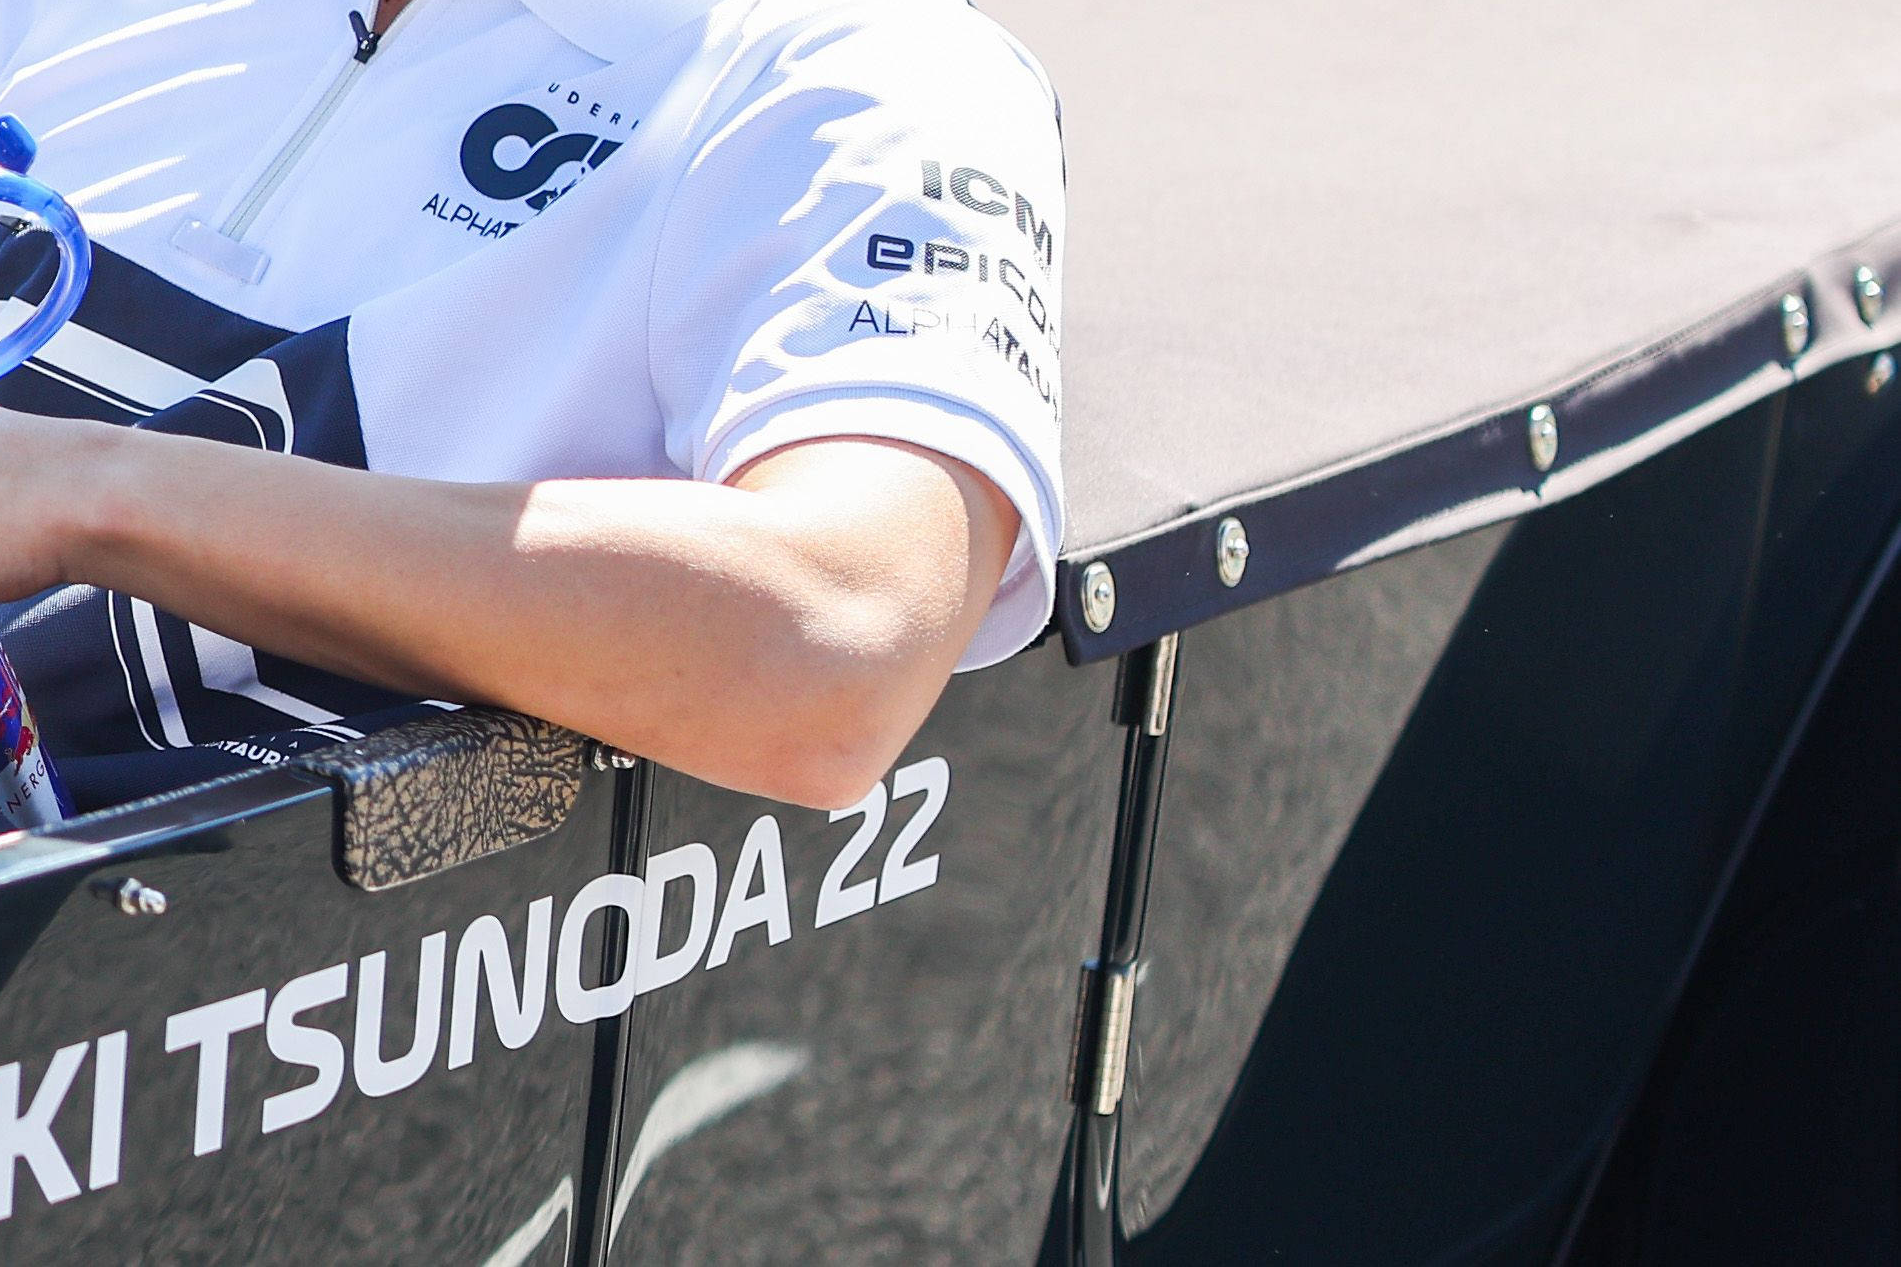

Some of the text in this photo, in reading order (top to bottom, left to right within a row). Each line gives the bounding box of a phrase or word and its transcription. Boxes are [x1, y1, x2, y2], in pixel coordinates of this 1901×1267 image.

[422, 193, 521, 239] ALPHAT
[921, 160, 1053, 266] ICM
[0, 759, 45, 814] NERG
[164, 814, 792, 1157] TSUNODA
[814, 756, 951, 929] 22
